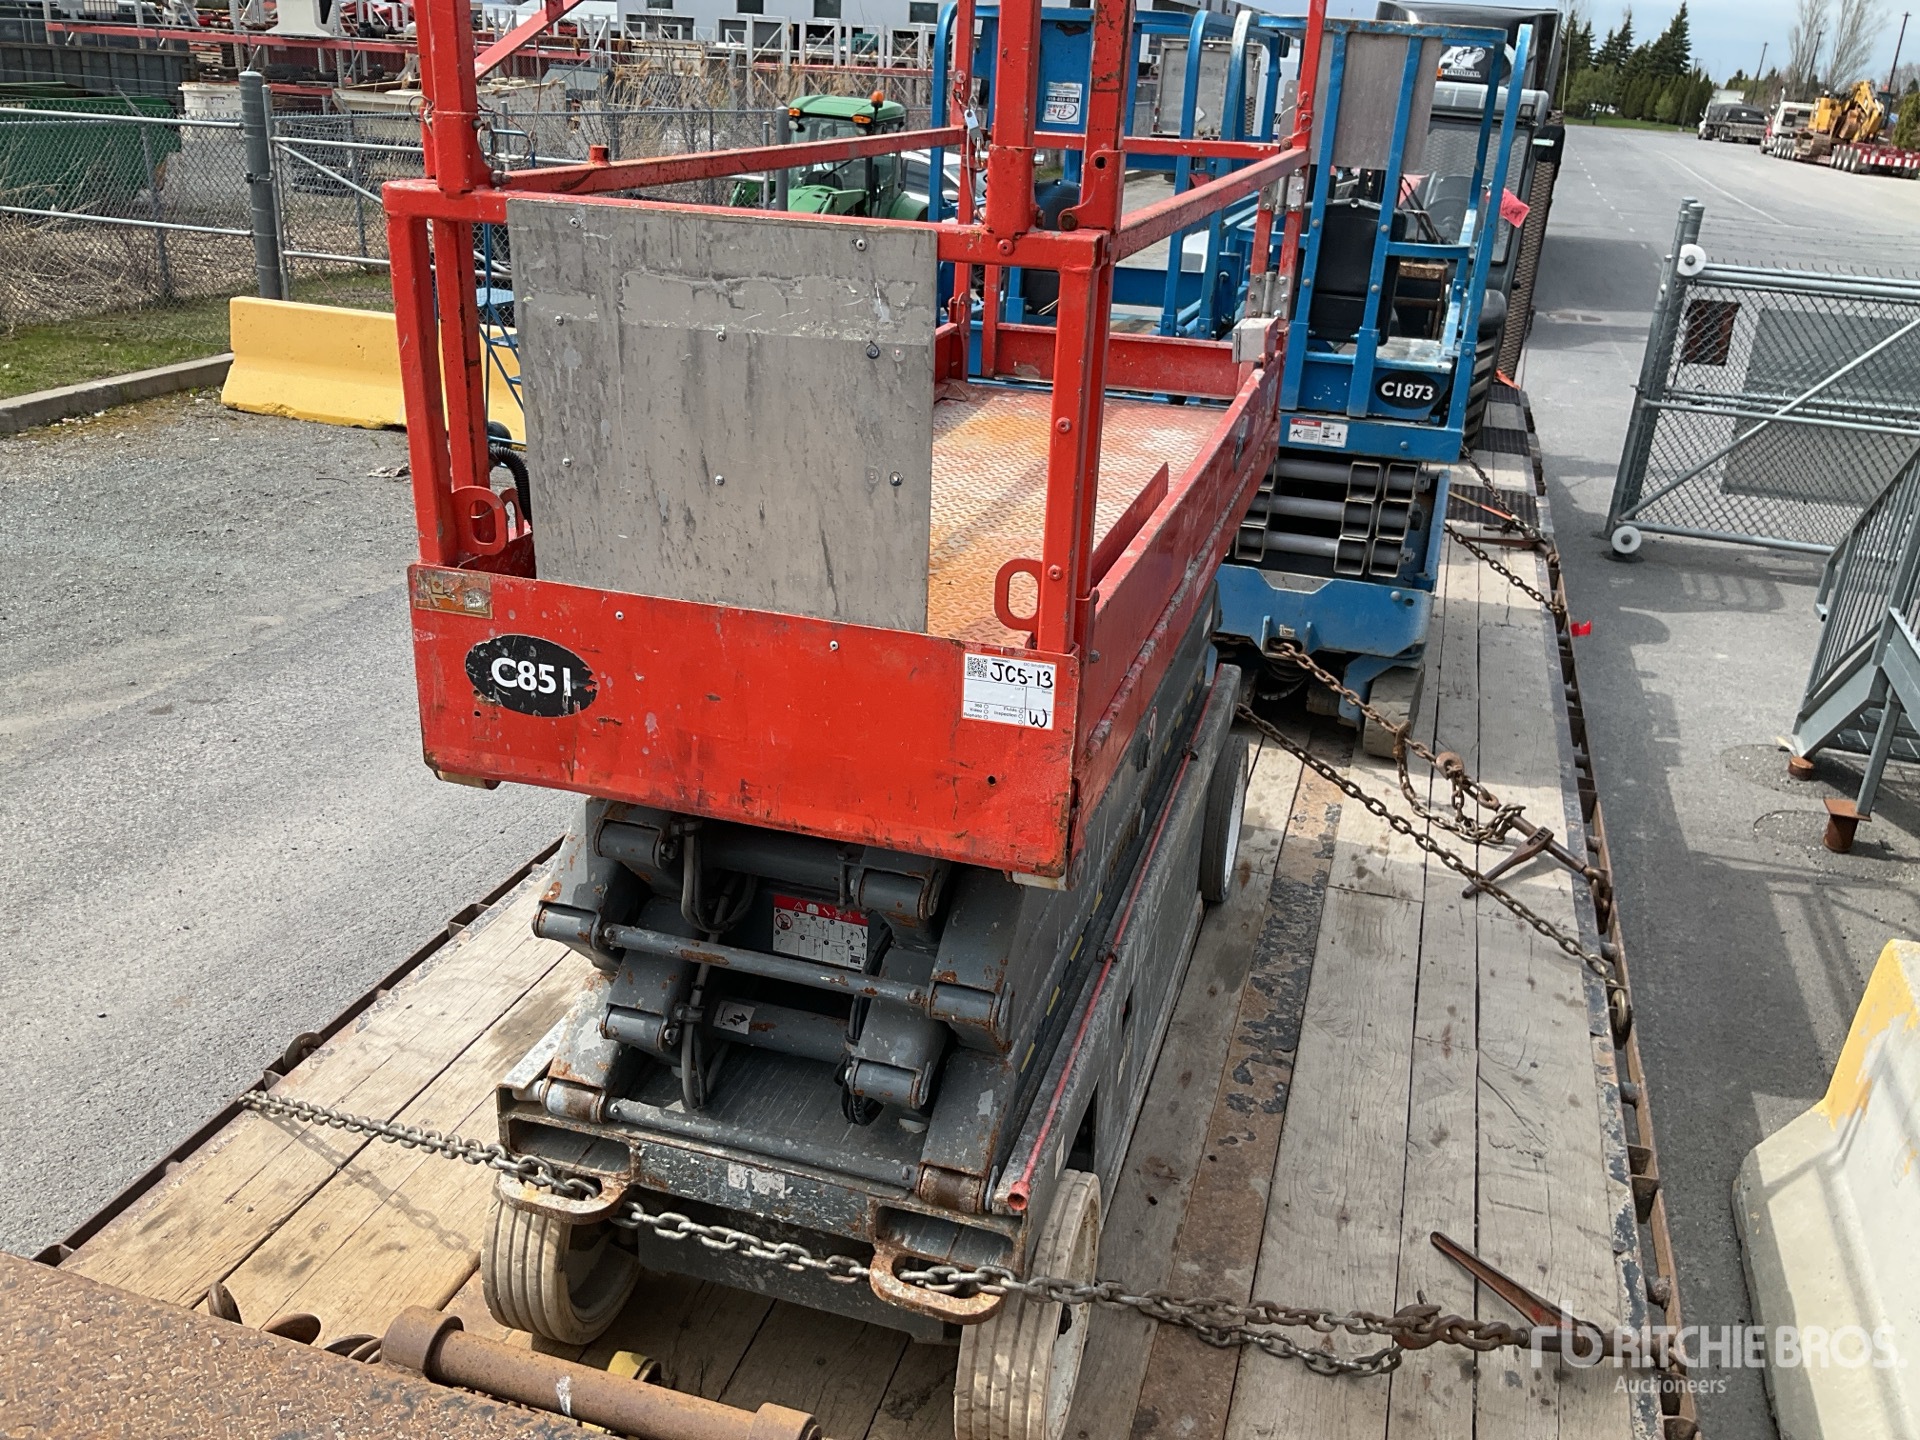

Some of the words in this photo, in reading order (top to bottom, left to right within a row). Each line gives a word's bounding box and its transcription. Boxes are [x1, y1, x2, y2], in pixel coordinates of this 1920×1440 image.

[1381, 381, 1434, 401] C1873
[491, 657, 572, 697] C851
[990, 662, 1053, 688] JC5-13
